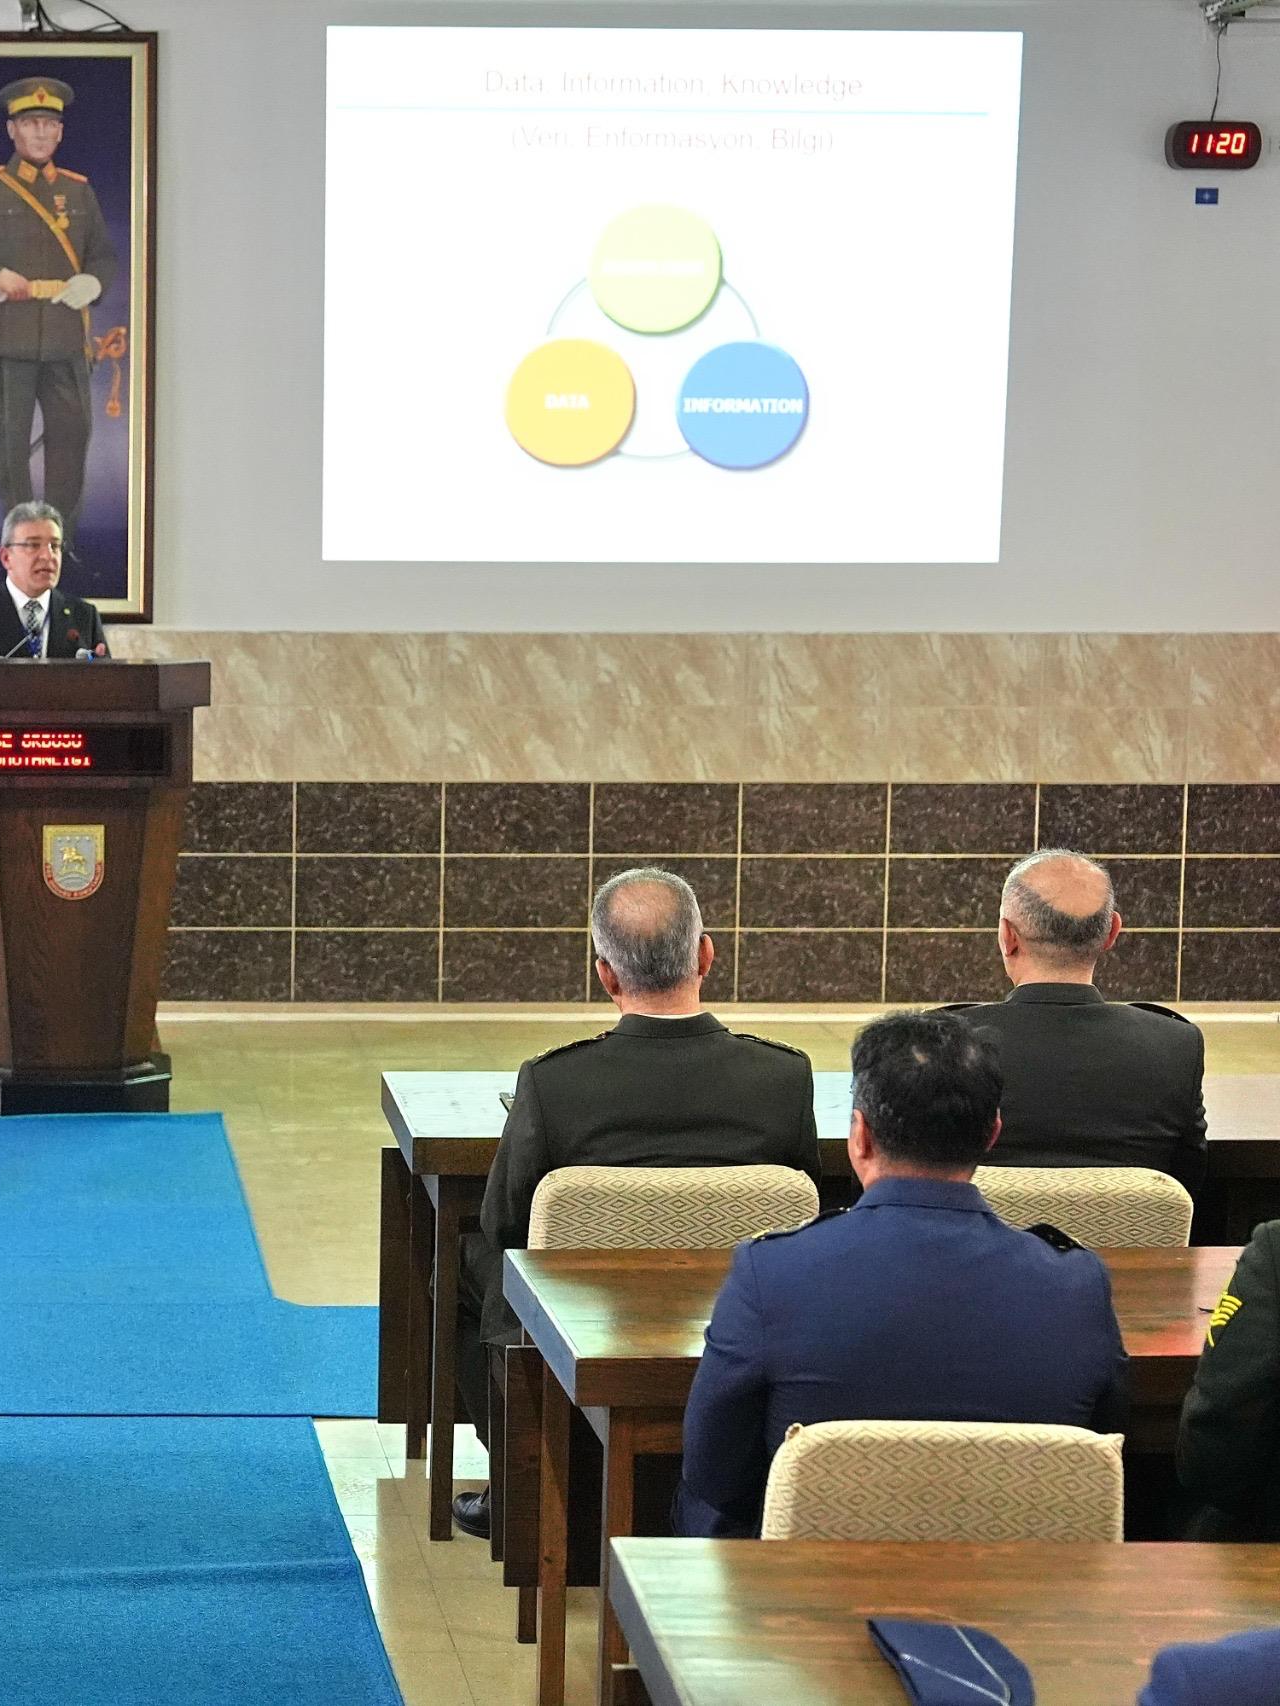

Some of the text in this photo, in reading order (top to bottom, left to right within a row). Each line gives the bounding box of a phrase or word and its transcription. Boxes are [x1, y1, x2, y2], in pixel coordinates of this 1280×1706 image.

[722, 72, 863, 101] Knowledge
[544, 393, 590, 409] DATA
[683, 397, 803, 414] INFORMATION
